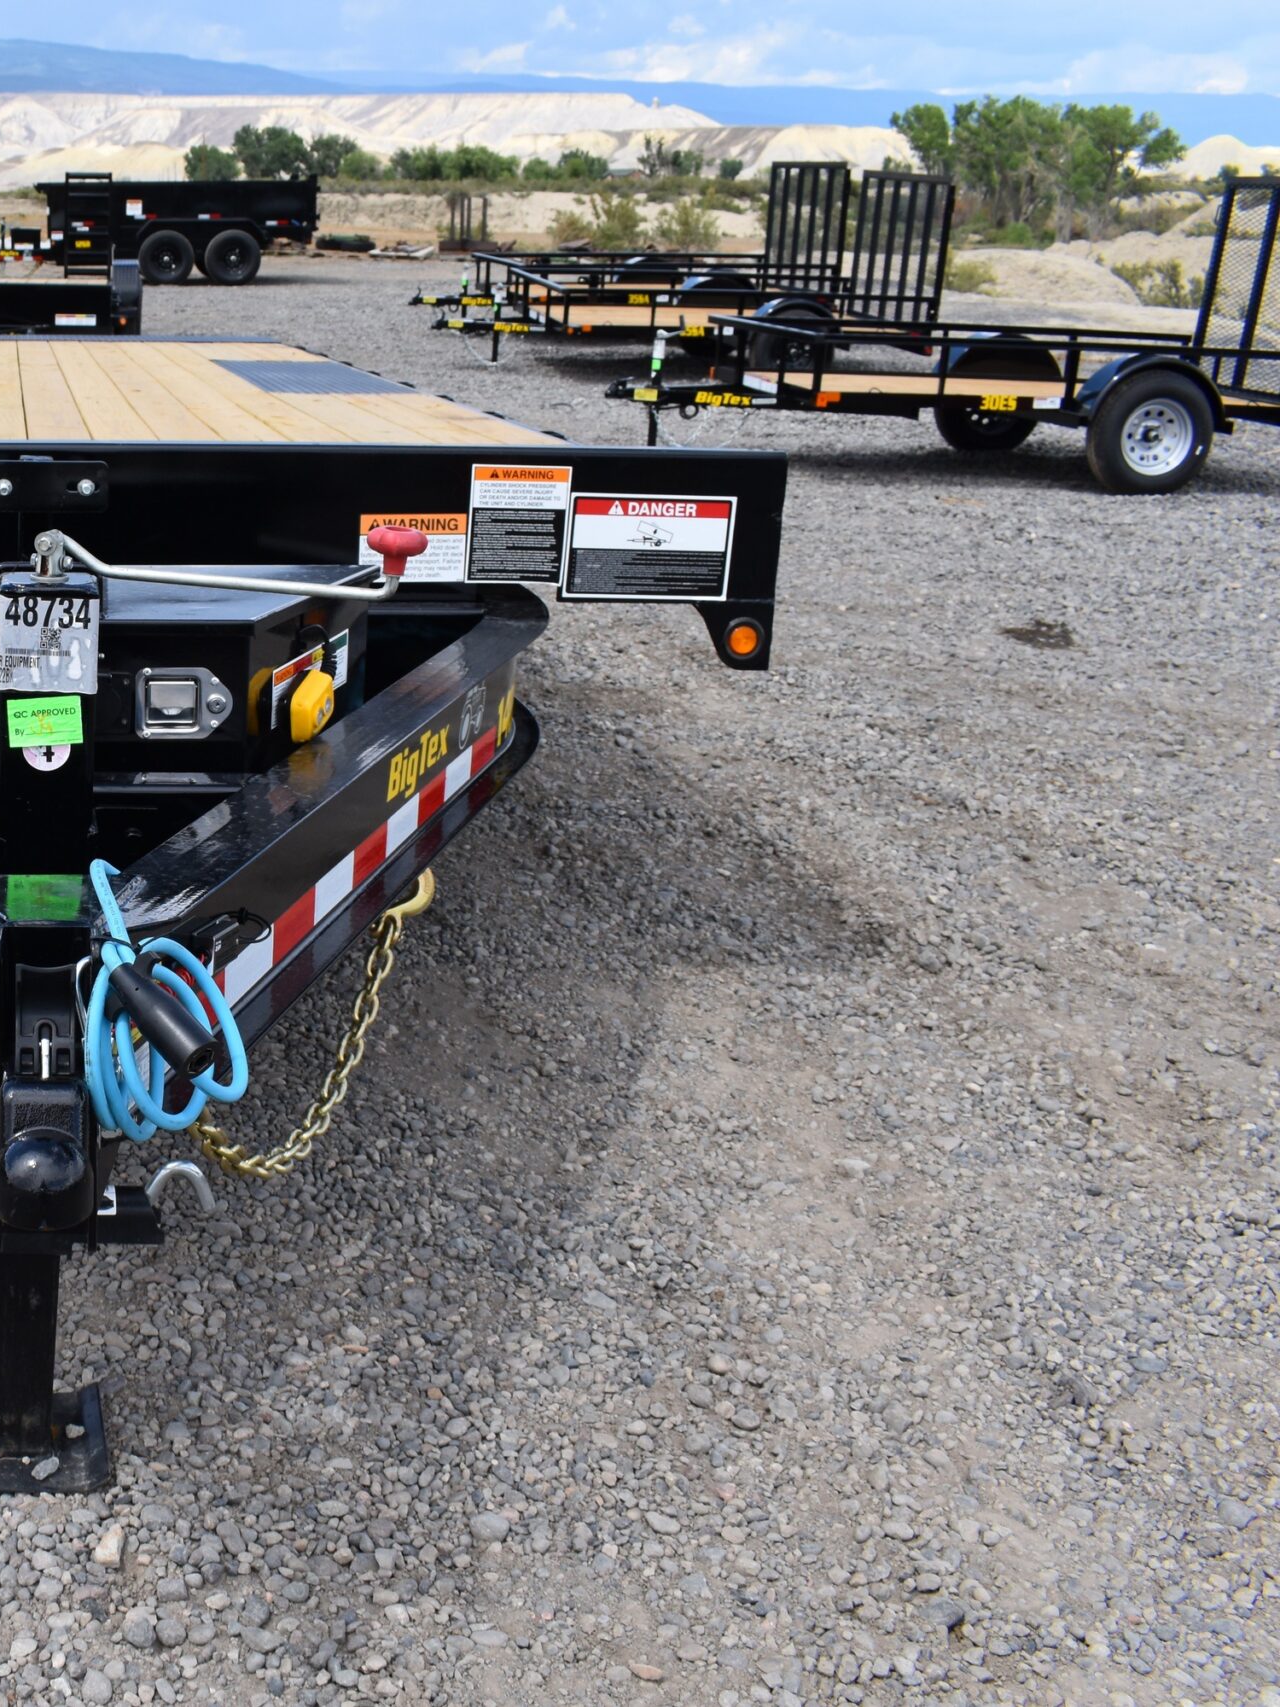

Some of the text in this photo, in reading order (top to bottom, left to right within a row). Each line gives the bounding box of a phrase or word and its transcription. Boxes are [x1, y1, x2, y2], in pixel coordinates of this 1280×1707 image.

[494, 322, 529, 334] BigTex
[695, 391, 752, 406] BigTex
[980, 394, 1017, 411] 30ES
[502, 470, 554, 480] WARNING
[628, 502, 697, 517] DANGER
[383, 518, 459, 531] WARNING
[5, 597, 91, 629] 48734
[13, 707, 76, 719] QC APPROVED
[15, 728, 25, 737] By
[386, 723, 450, 803] BigTex
